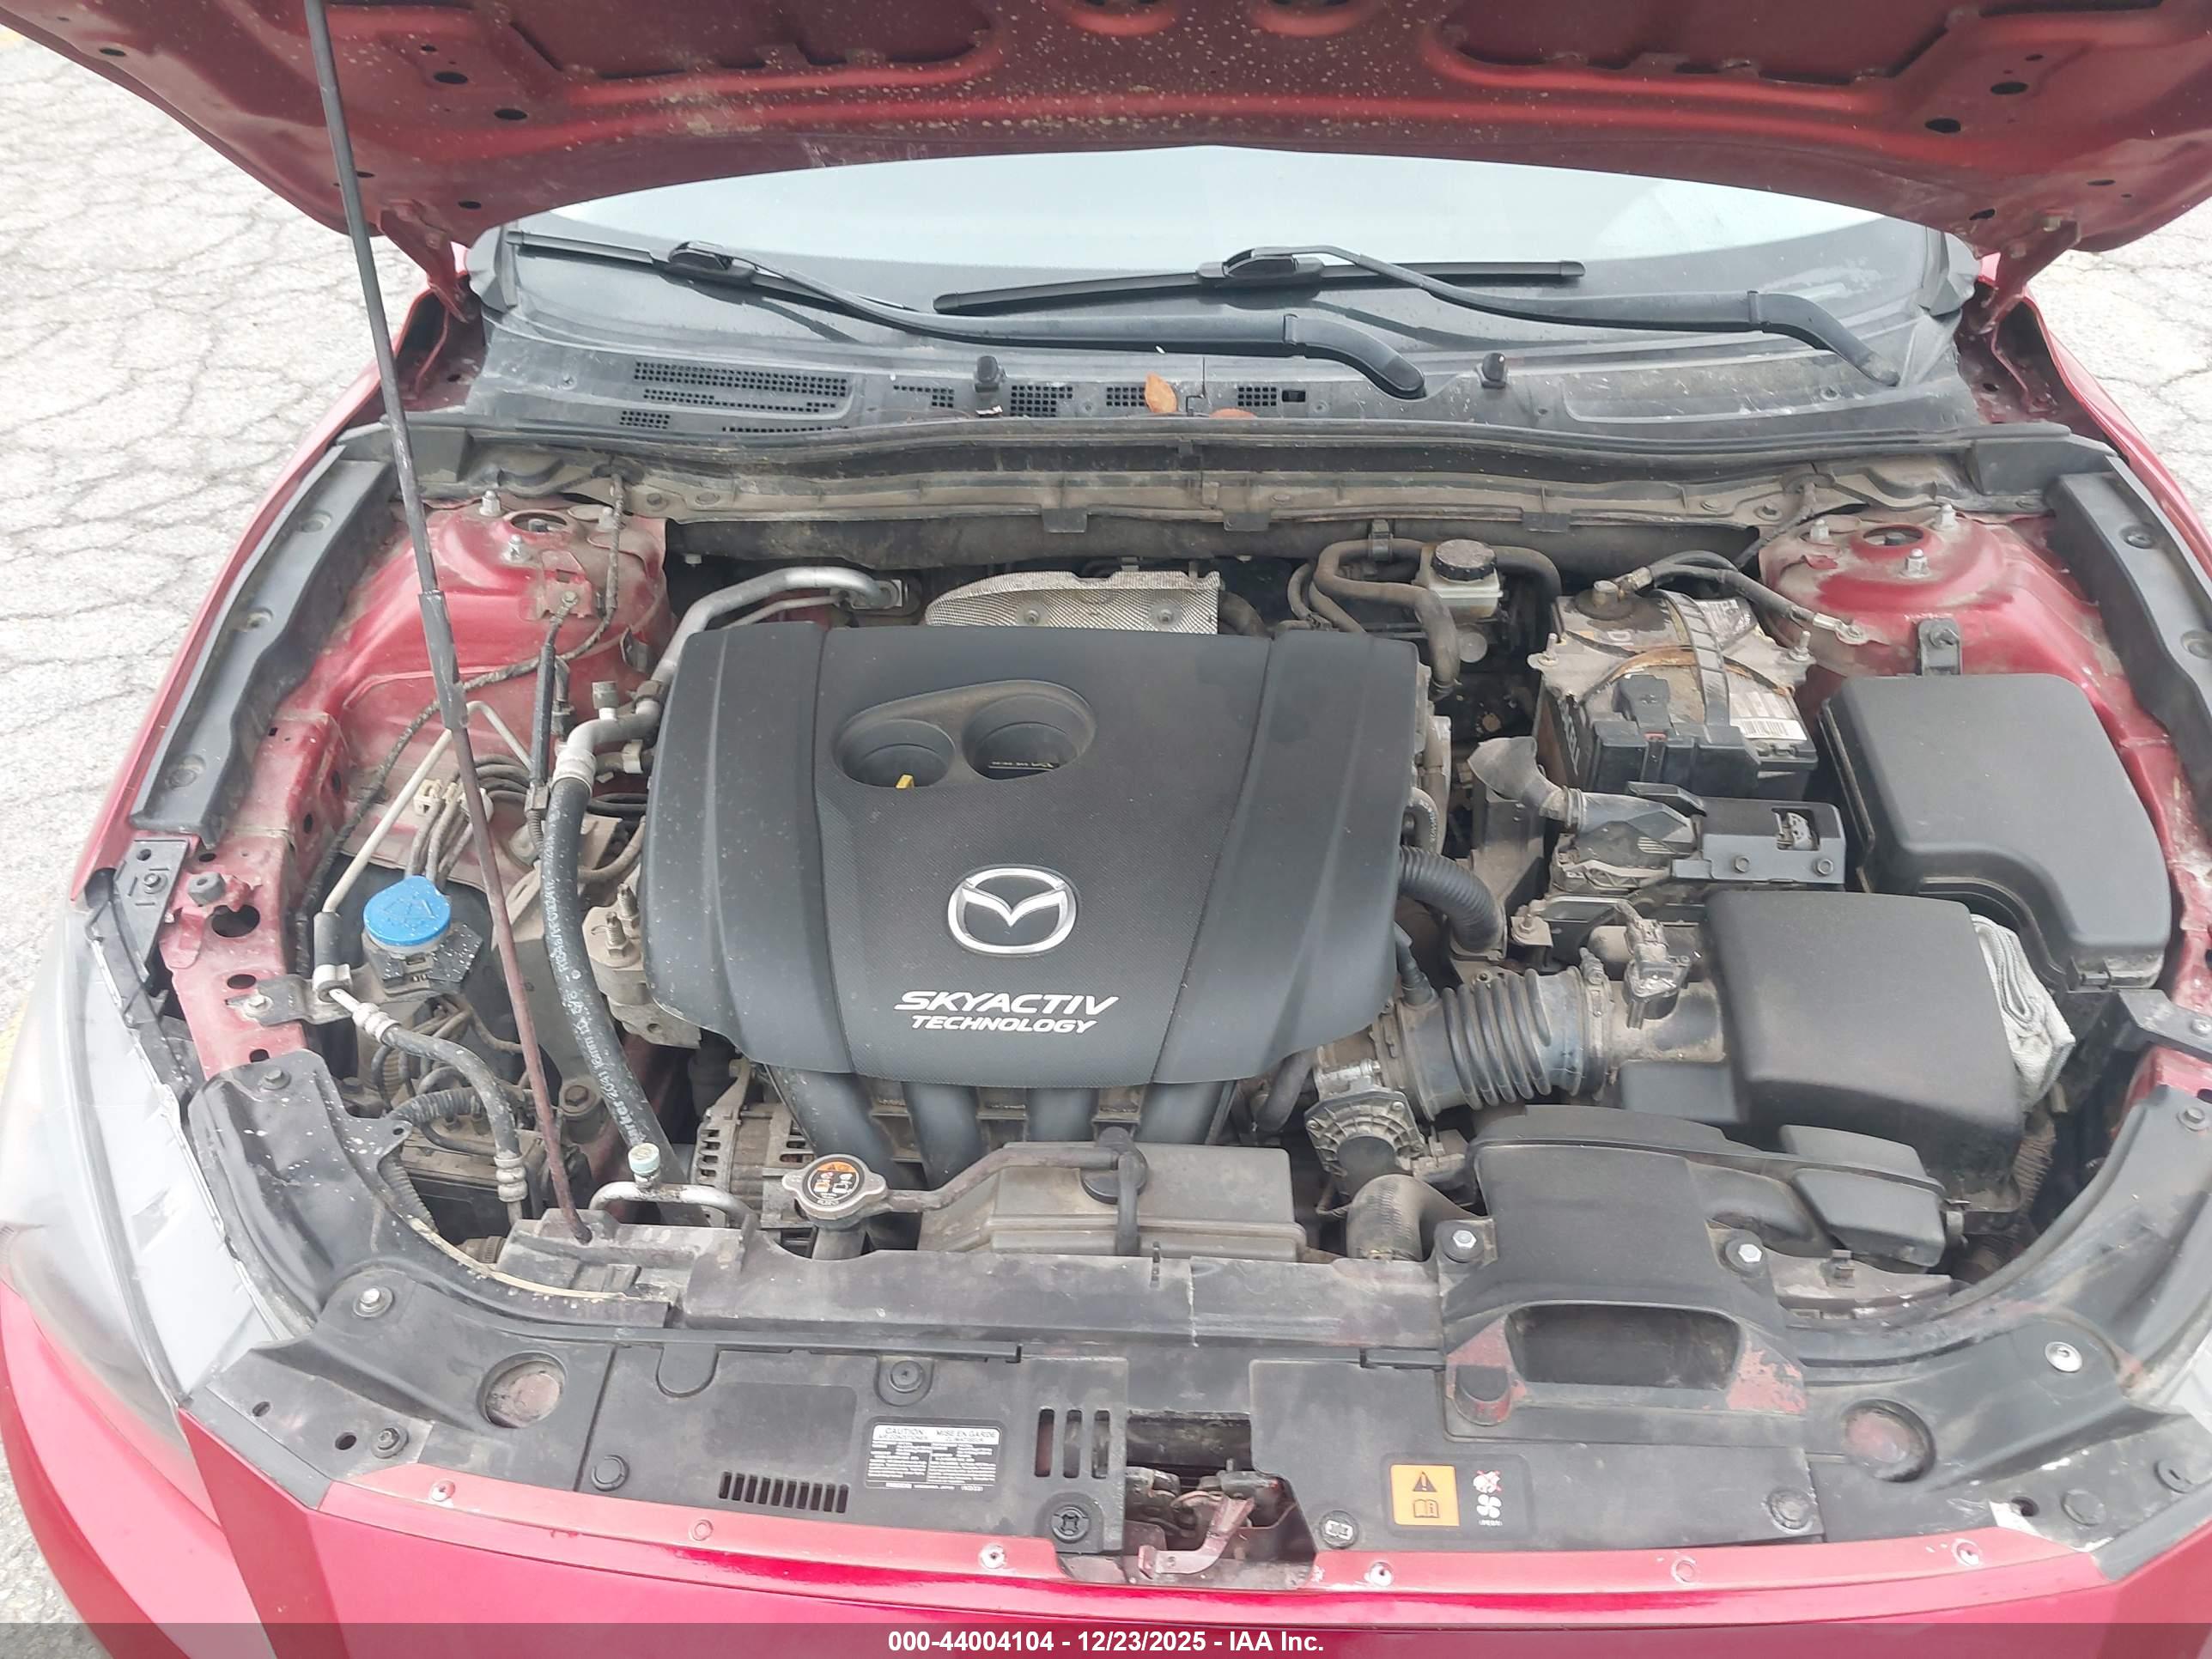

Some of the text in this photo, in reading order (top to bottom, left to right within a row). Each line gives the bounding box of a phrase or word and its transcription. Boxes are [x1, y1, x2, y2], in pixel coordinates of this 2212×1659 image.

[894, 990, 1119, 1016] SKYACTIV
[911, 1014, 1097, 1034] TECHNOLOGY
[596, 1068, 620, 1102] 2041
